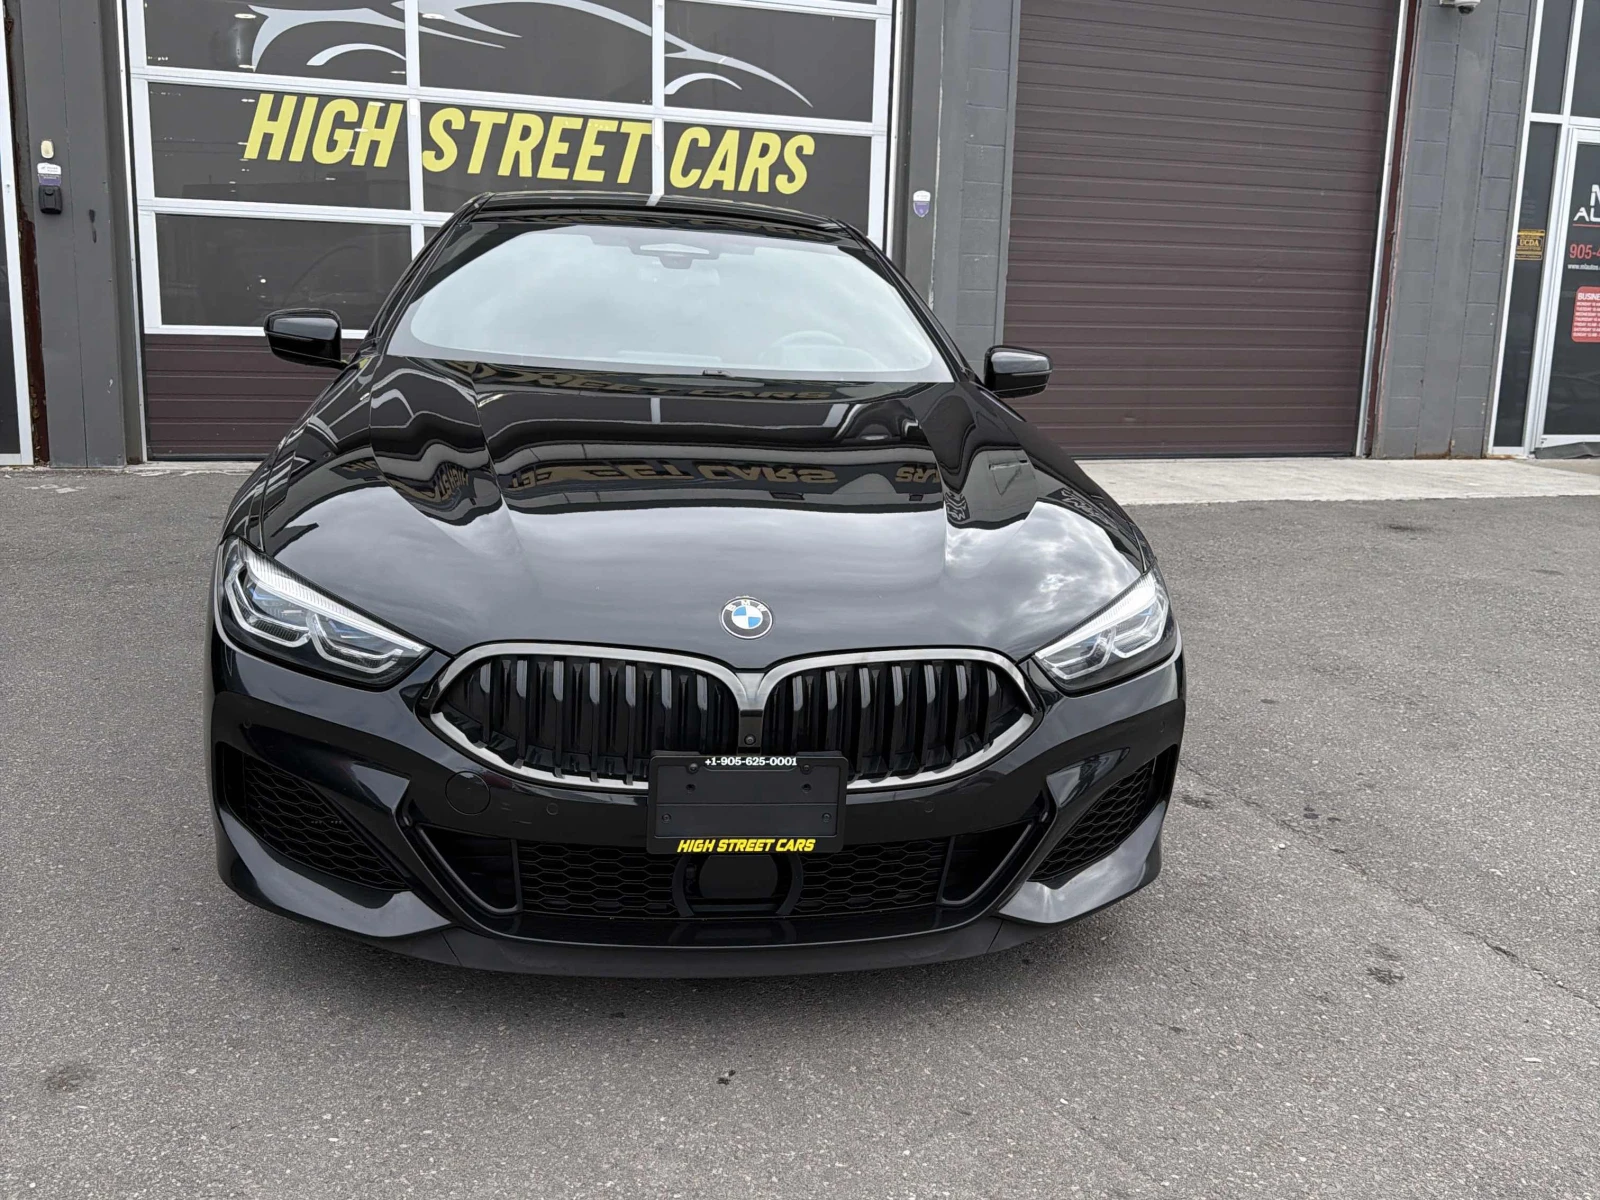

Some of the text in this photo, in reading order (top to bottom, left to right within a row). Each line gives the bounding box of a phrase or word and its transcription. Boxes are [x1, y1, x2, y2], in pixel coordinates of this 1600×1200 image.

[243, 93, 816, 195] HIGH STREET CARS
[1519, 239, 1540, 247] UCDA
[704, 756, 798, 766] +1-905-625-0001
[677, 838, 816, 853] HIGH STREET CARS
